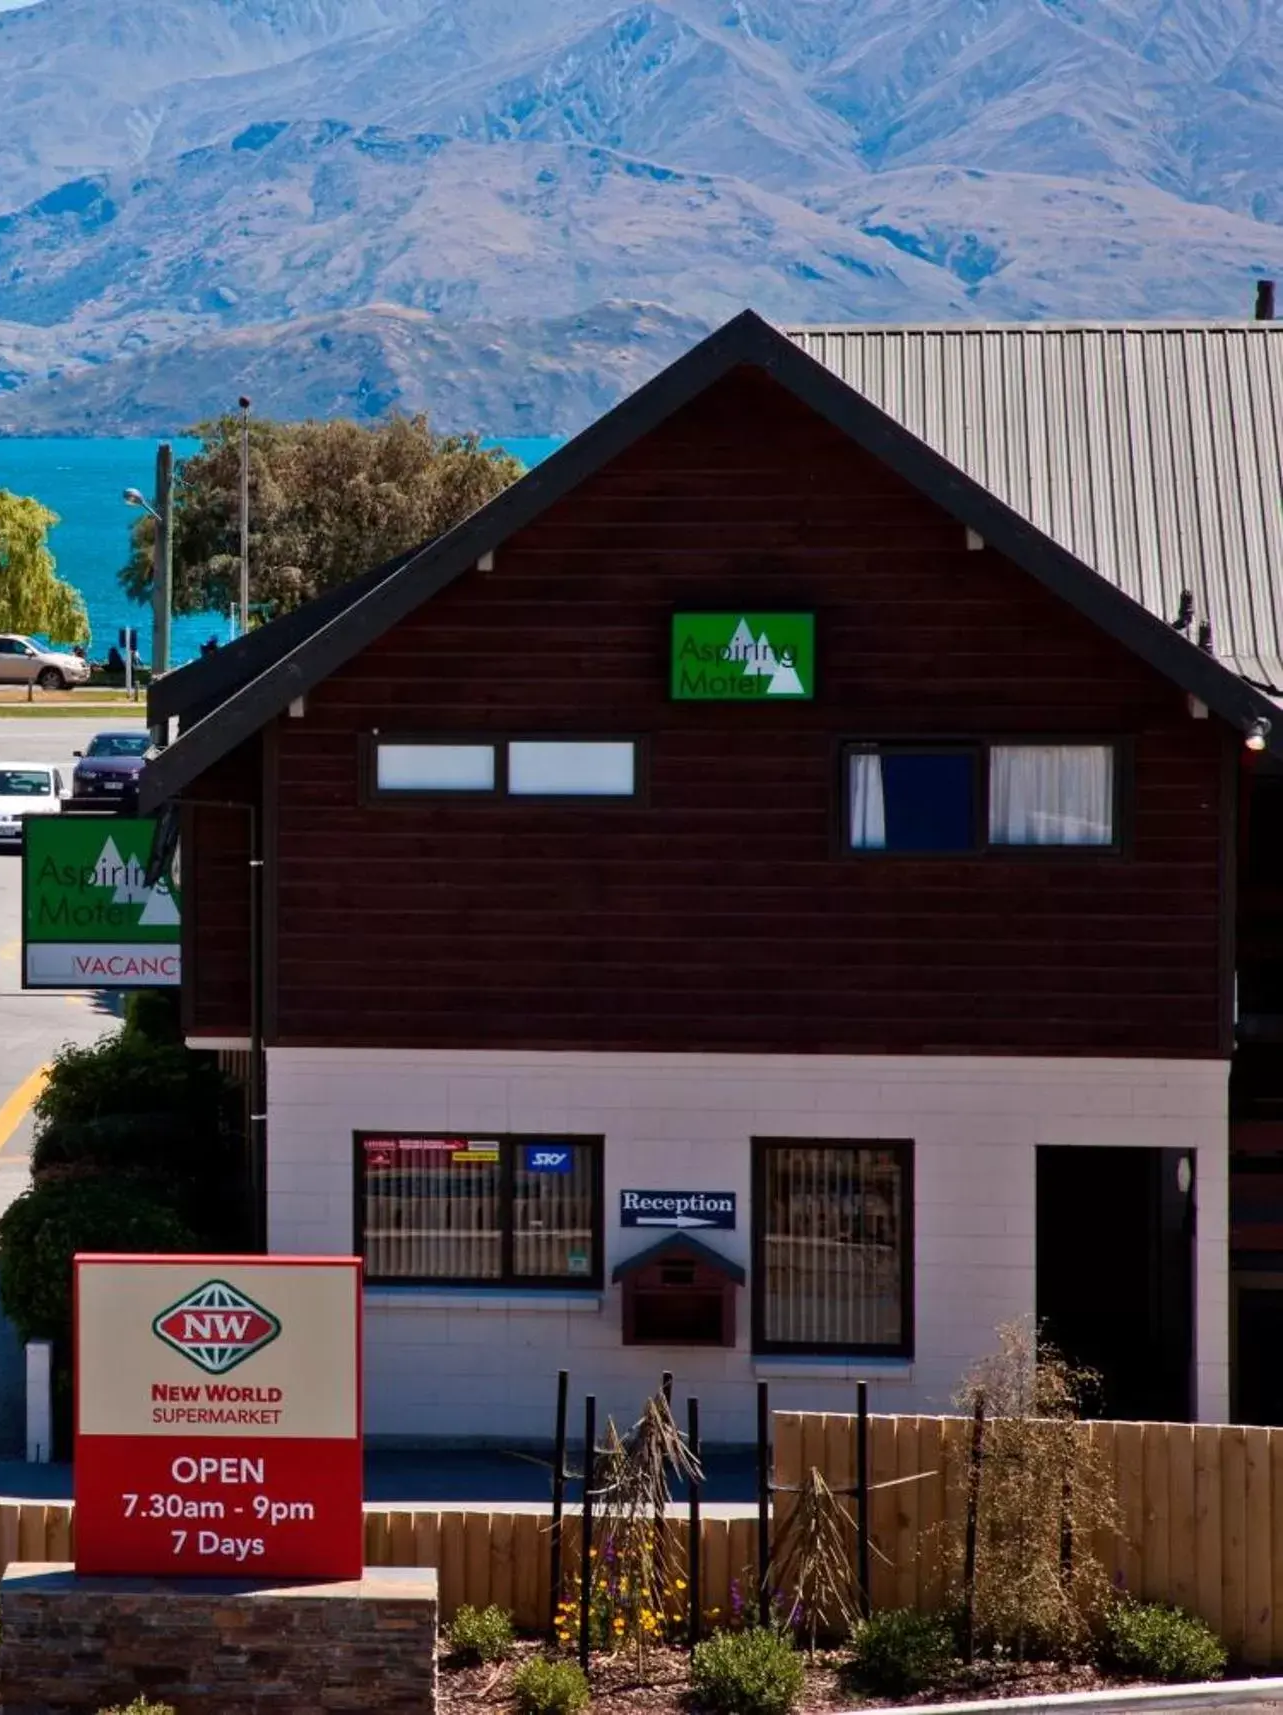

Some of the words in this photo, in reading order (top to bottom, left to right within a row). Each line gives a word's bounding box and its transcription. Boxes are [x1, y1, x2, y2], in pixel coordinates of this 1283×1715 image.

[679, 634, 797, 667] Aspiring
[680, 668, 761, 695] Motel
[38, 895, 132, 926] Motel
[75, 956, 181, 976] VACANC
[532, 1153, 566, 1165] SKY
[622, 1192, 734, 1214] Reception
[183, 1313, 251, 1340] NW
[152, 1384, 200, 1402] NEW
[207, 1385, 282, 1402] WORLD
[152, 1408, 283, 1424] SUPERMARKET
[171, 1457, 265, 1484] OPEN
[122, 1494, 224, 1519] 7.30am
[252, 1497, 315, 1526] 9pm
[171, 1531, 187, 1554] 7
[198, 1532, 266, 1562] Days
